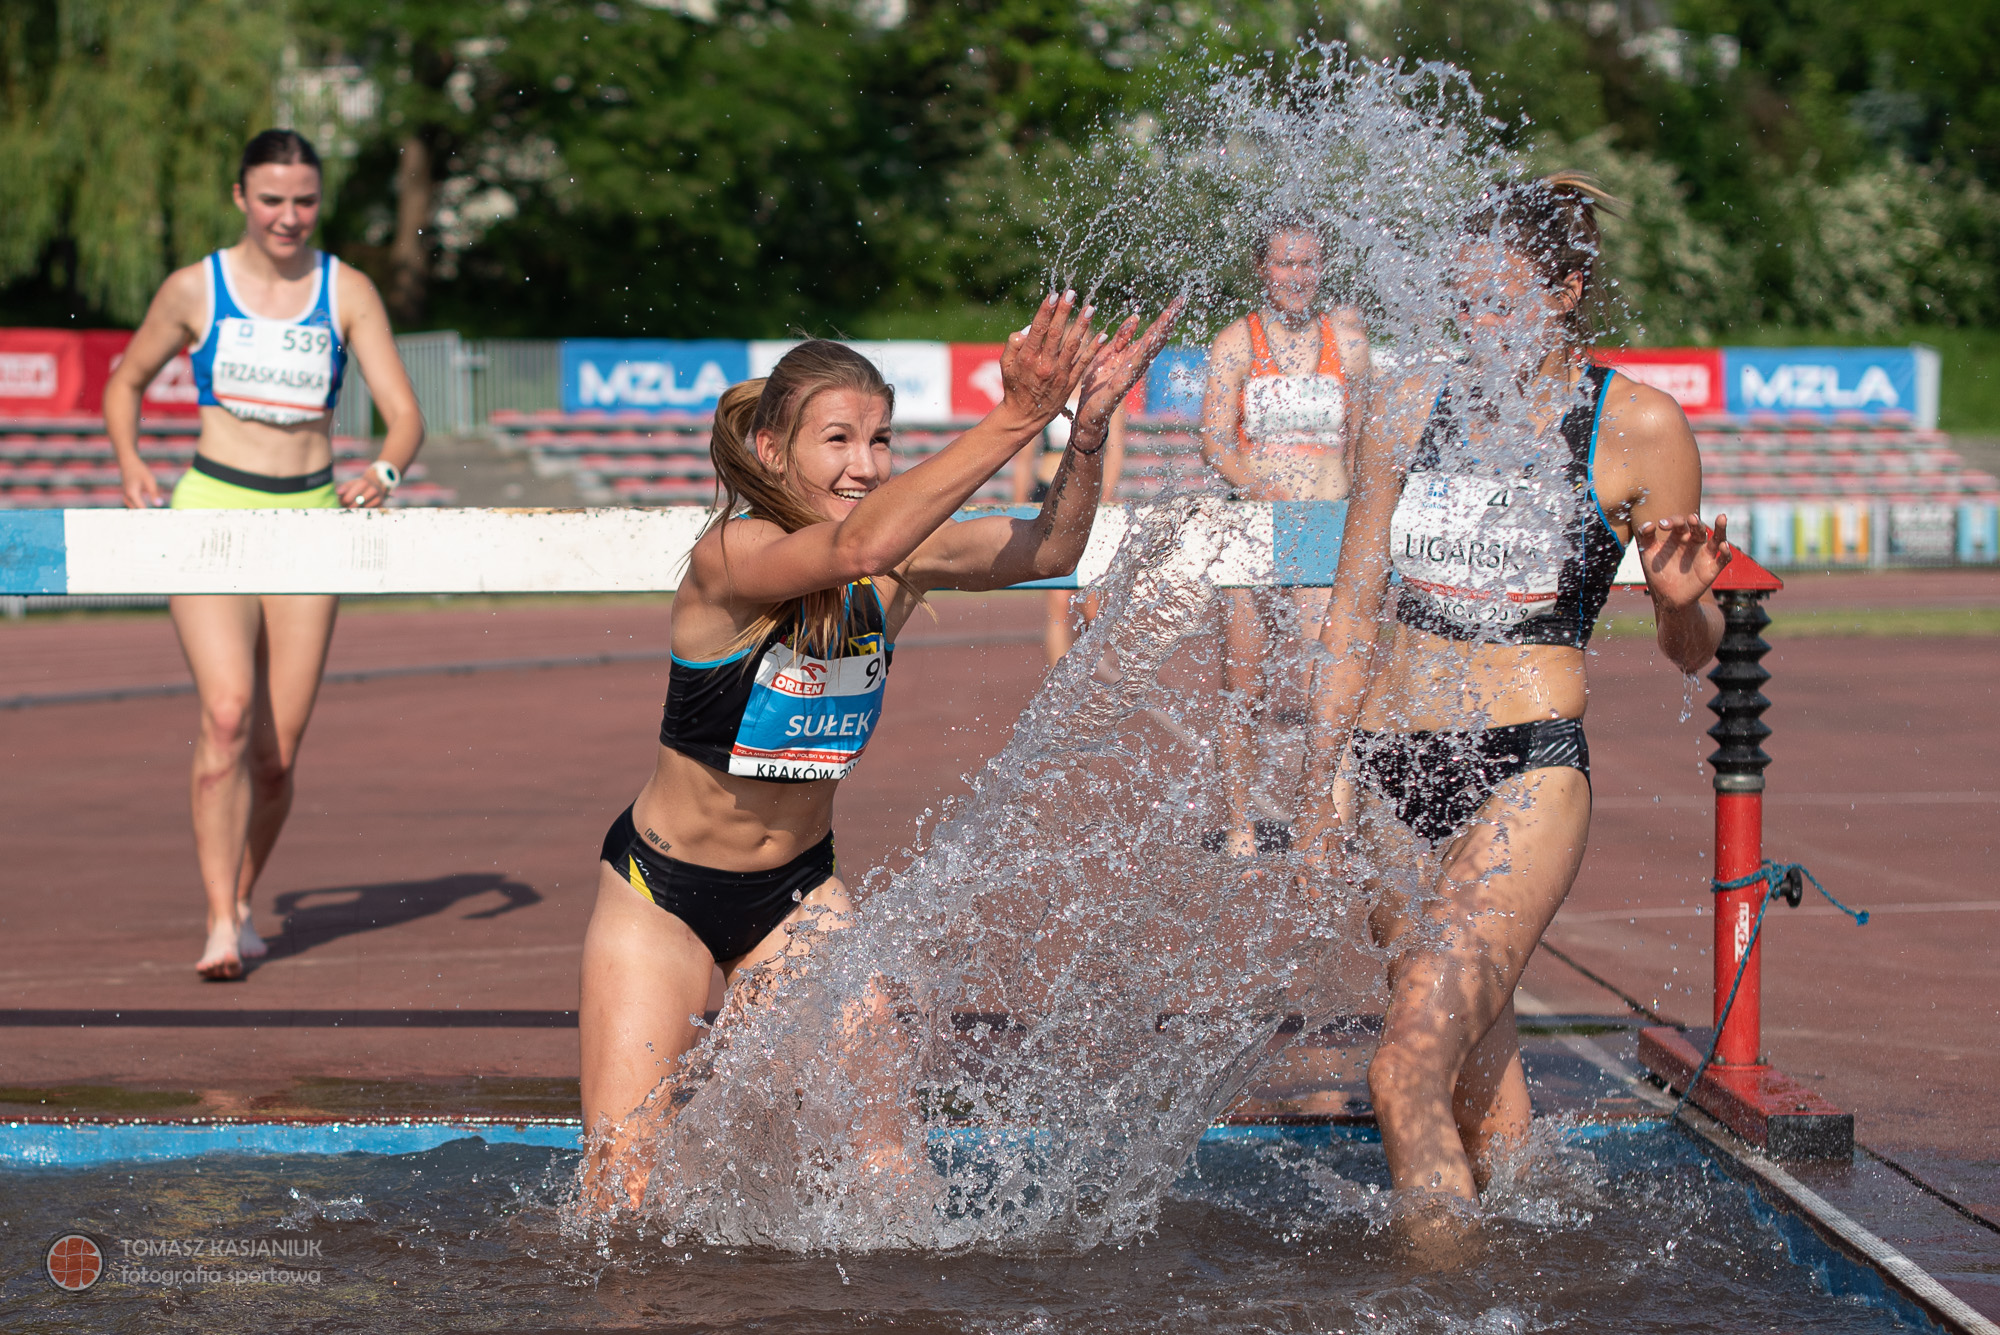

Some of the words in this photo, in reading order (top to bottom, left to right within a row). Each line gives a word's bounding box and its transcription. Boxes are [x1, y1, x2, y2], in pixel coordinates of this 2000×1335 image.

[282, 329, 329, 354] 539
[220, 361, 325, 390] TRZASKALSKA
[579, 360, 731, 405] MZLA
[1740, 363, 1900, 408] MZLA
[1405, 533, 1537, 571] LIGARSK
[774, 677, 823, 695] ORLEN
[864, 656, 884, 689] 9
[785, 708, 874, 737] SUŁEK
[756, 763, 835, 780] KRAKÓW
